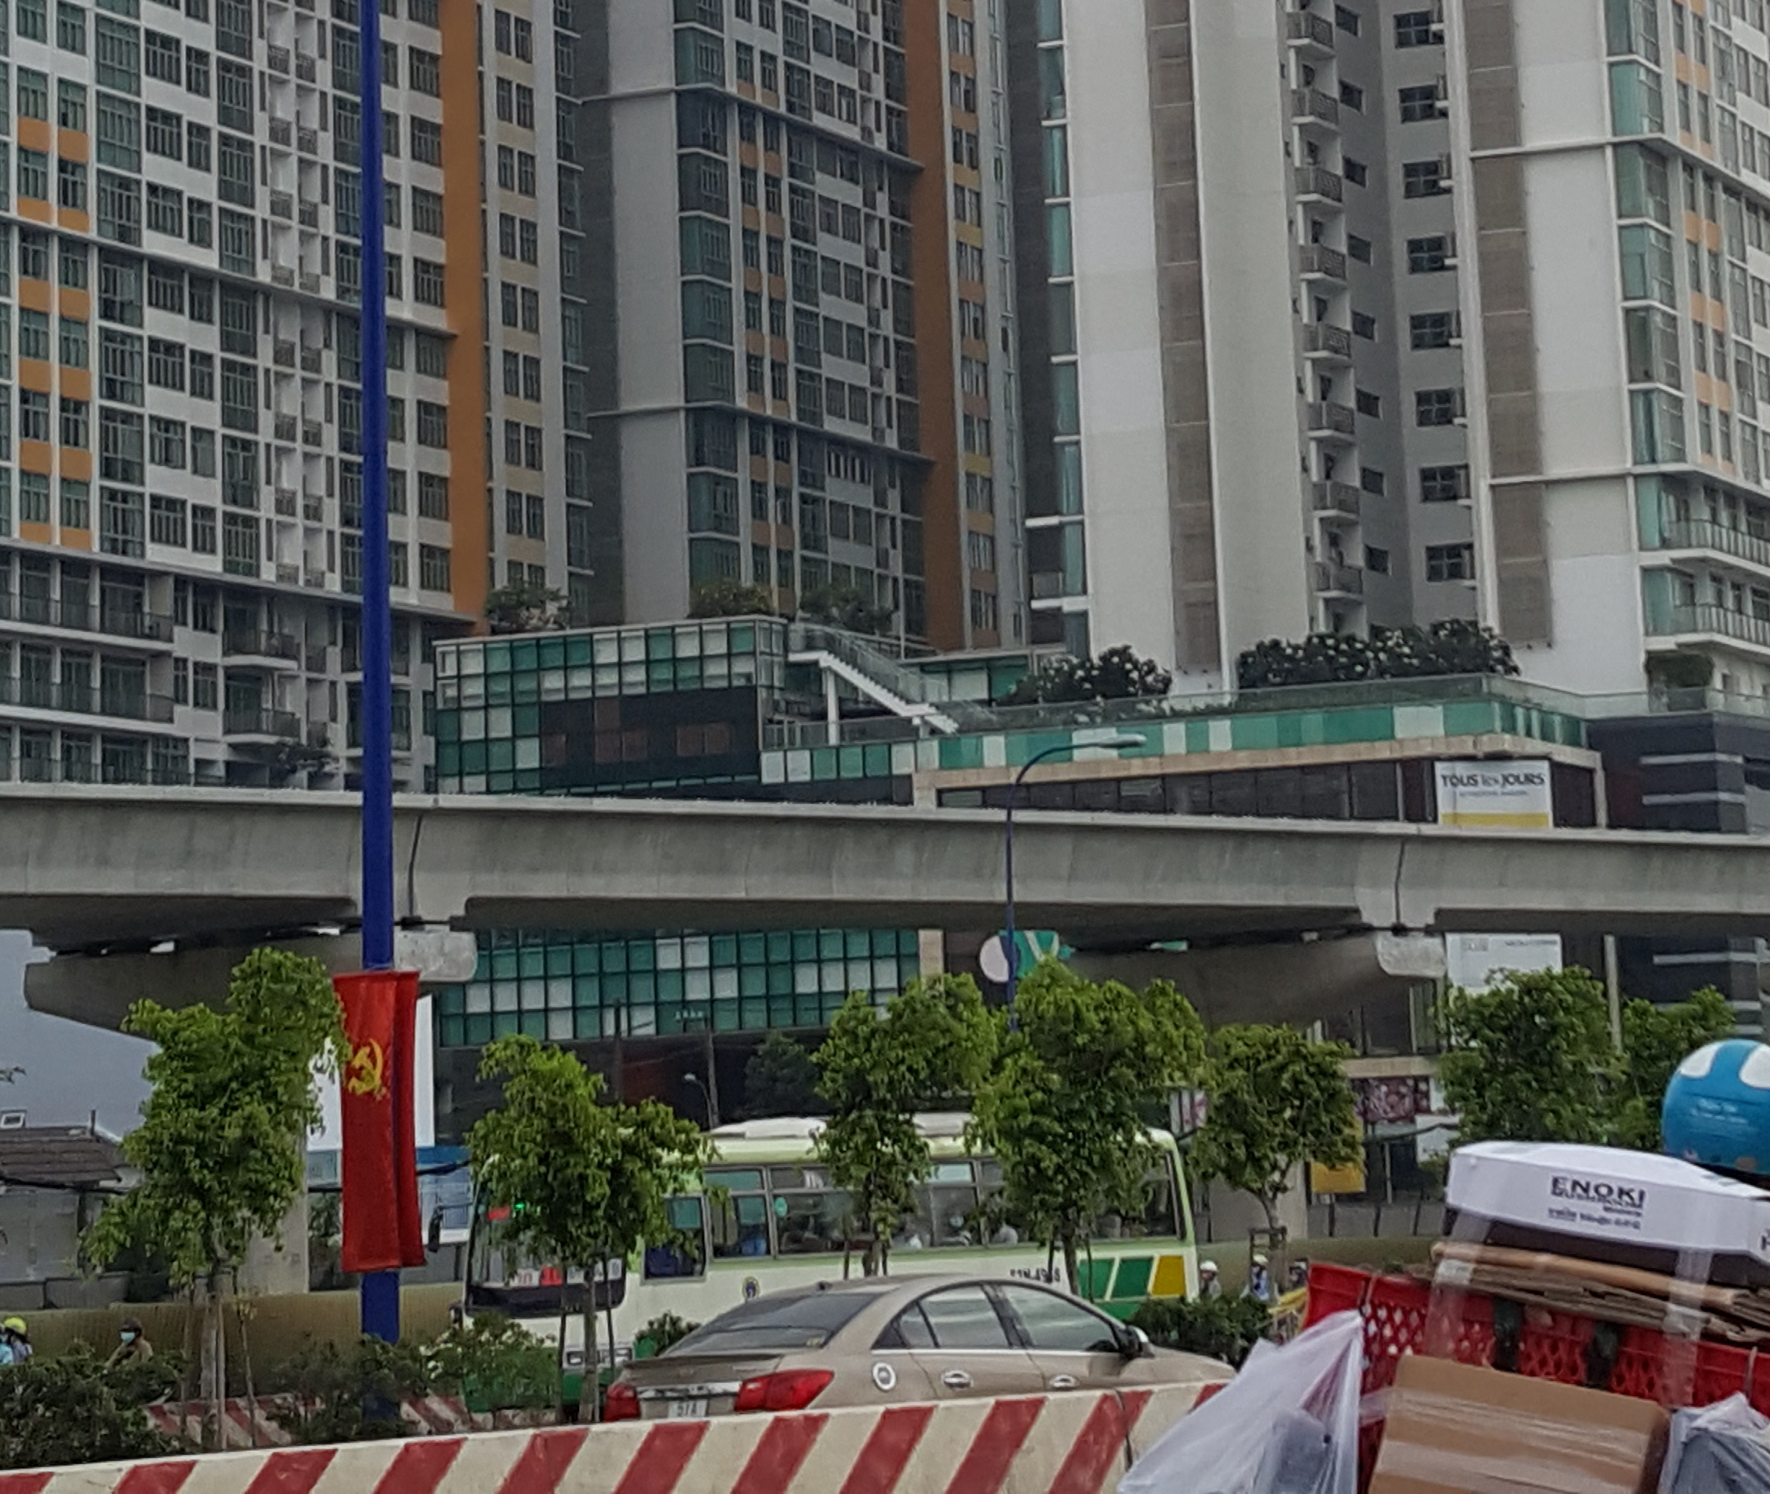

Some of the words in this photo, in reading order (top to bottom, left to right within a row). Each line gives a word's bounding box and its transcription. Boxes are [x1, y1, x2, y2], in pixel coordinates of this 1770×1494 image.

[1441, 774, 1478, 787] TOUS
[1500, 773, 1546, 788] JOURS
[1551, 1176, 1646, 1207] ENOKI
